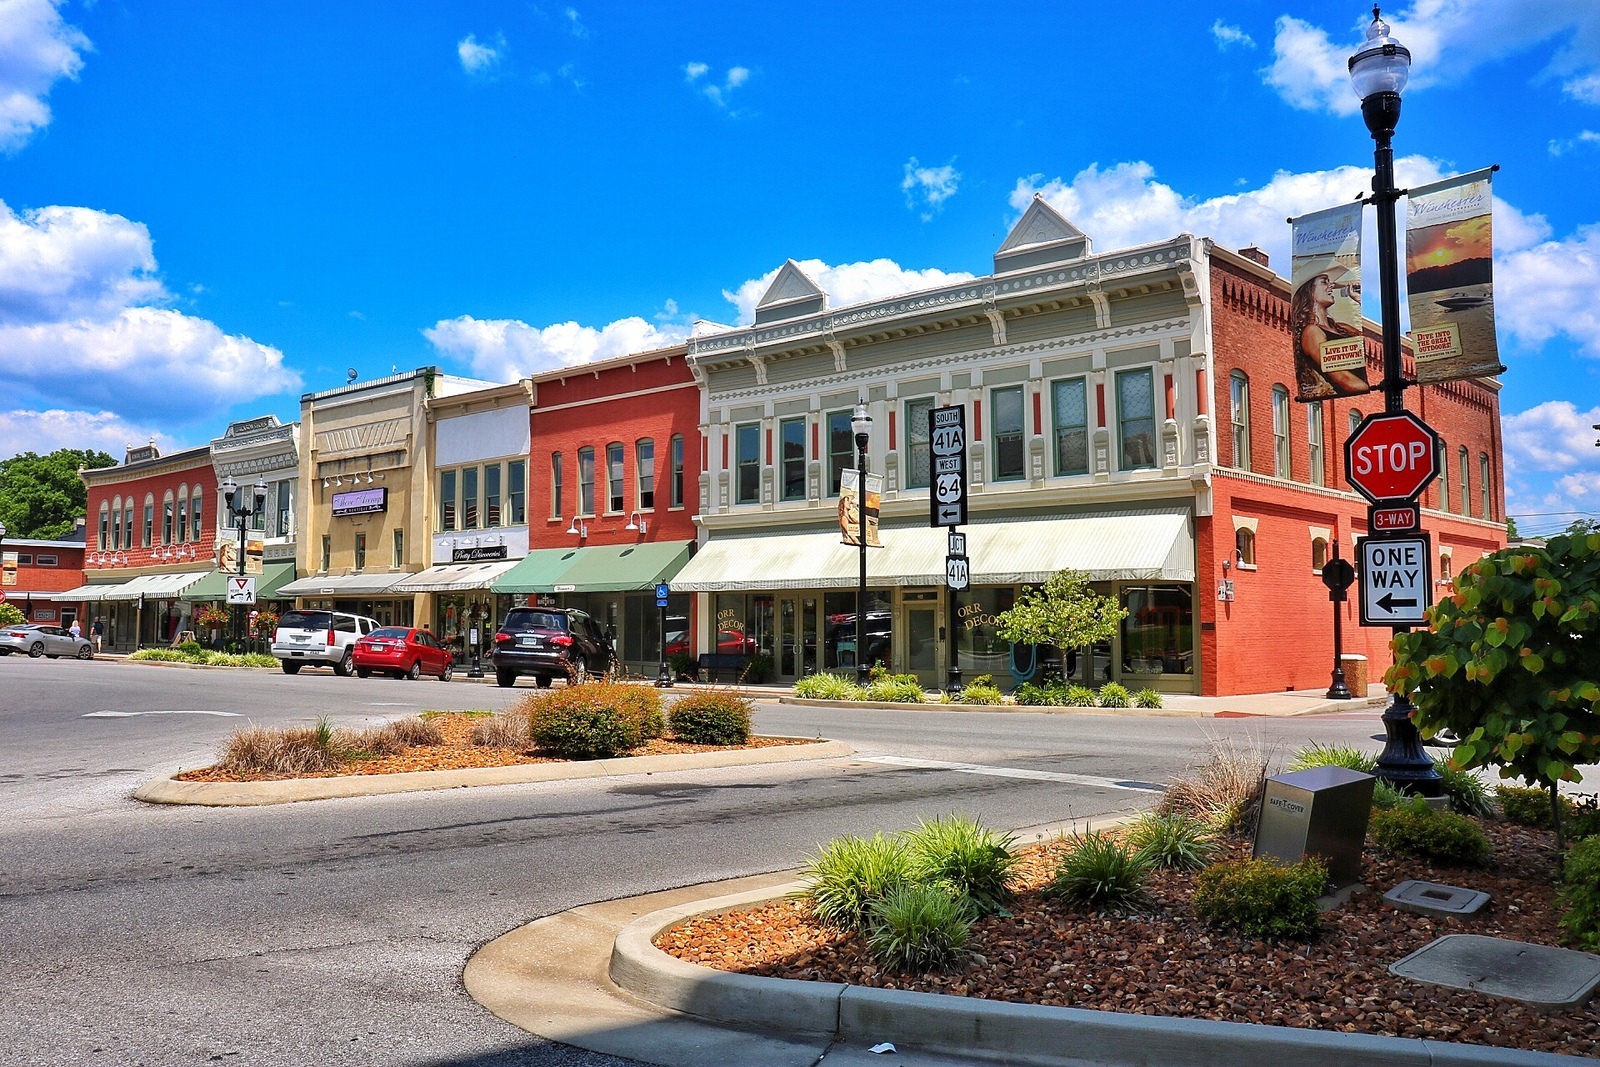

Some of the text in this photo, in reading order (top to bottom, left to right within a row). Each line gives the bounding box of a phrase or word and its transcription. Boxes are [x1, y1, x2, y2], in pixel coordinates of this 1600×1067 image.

[1414, 194, 1486, 216] Winchester
[1296, 226, 1356, 245] Winchester
[1417, 330, 1451, 341] DIVE INTO
[1431, 336, 1452, 345] GREAT
[1325, 347, 1341, 355] LIVE
[1418, 342, 1452, 353] OUTDOORS!
[1323, 349, 1362, 362] DOWNTOWN!
[937, 410, 958, 424] SOUTH
[935, 430, 963, 449] 41A
[940, 459, 958, 470] WEST
[1356, 441, 1426, 475] STOP
[938, 478, 960, 496] 64
[1376, 512, 1412, 526] 3-WAY
[951, 538, 964, 550] JCT
[1372, 547, 1417, 567] ONE
[949, 568, 967, 582] 41A
[1372, 569, 1419, 589] WAY
[717, 609, 734, 620] ORR
[957, 602, 982, 618] ORR
[718, 620, 744, 631] DECOR
[1270, 798, 1305, 813] SAFE-T-COVER
